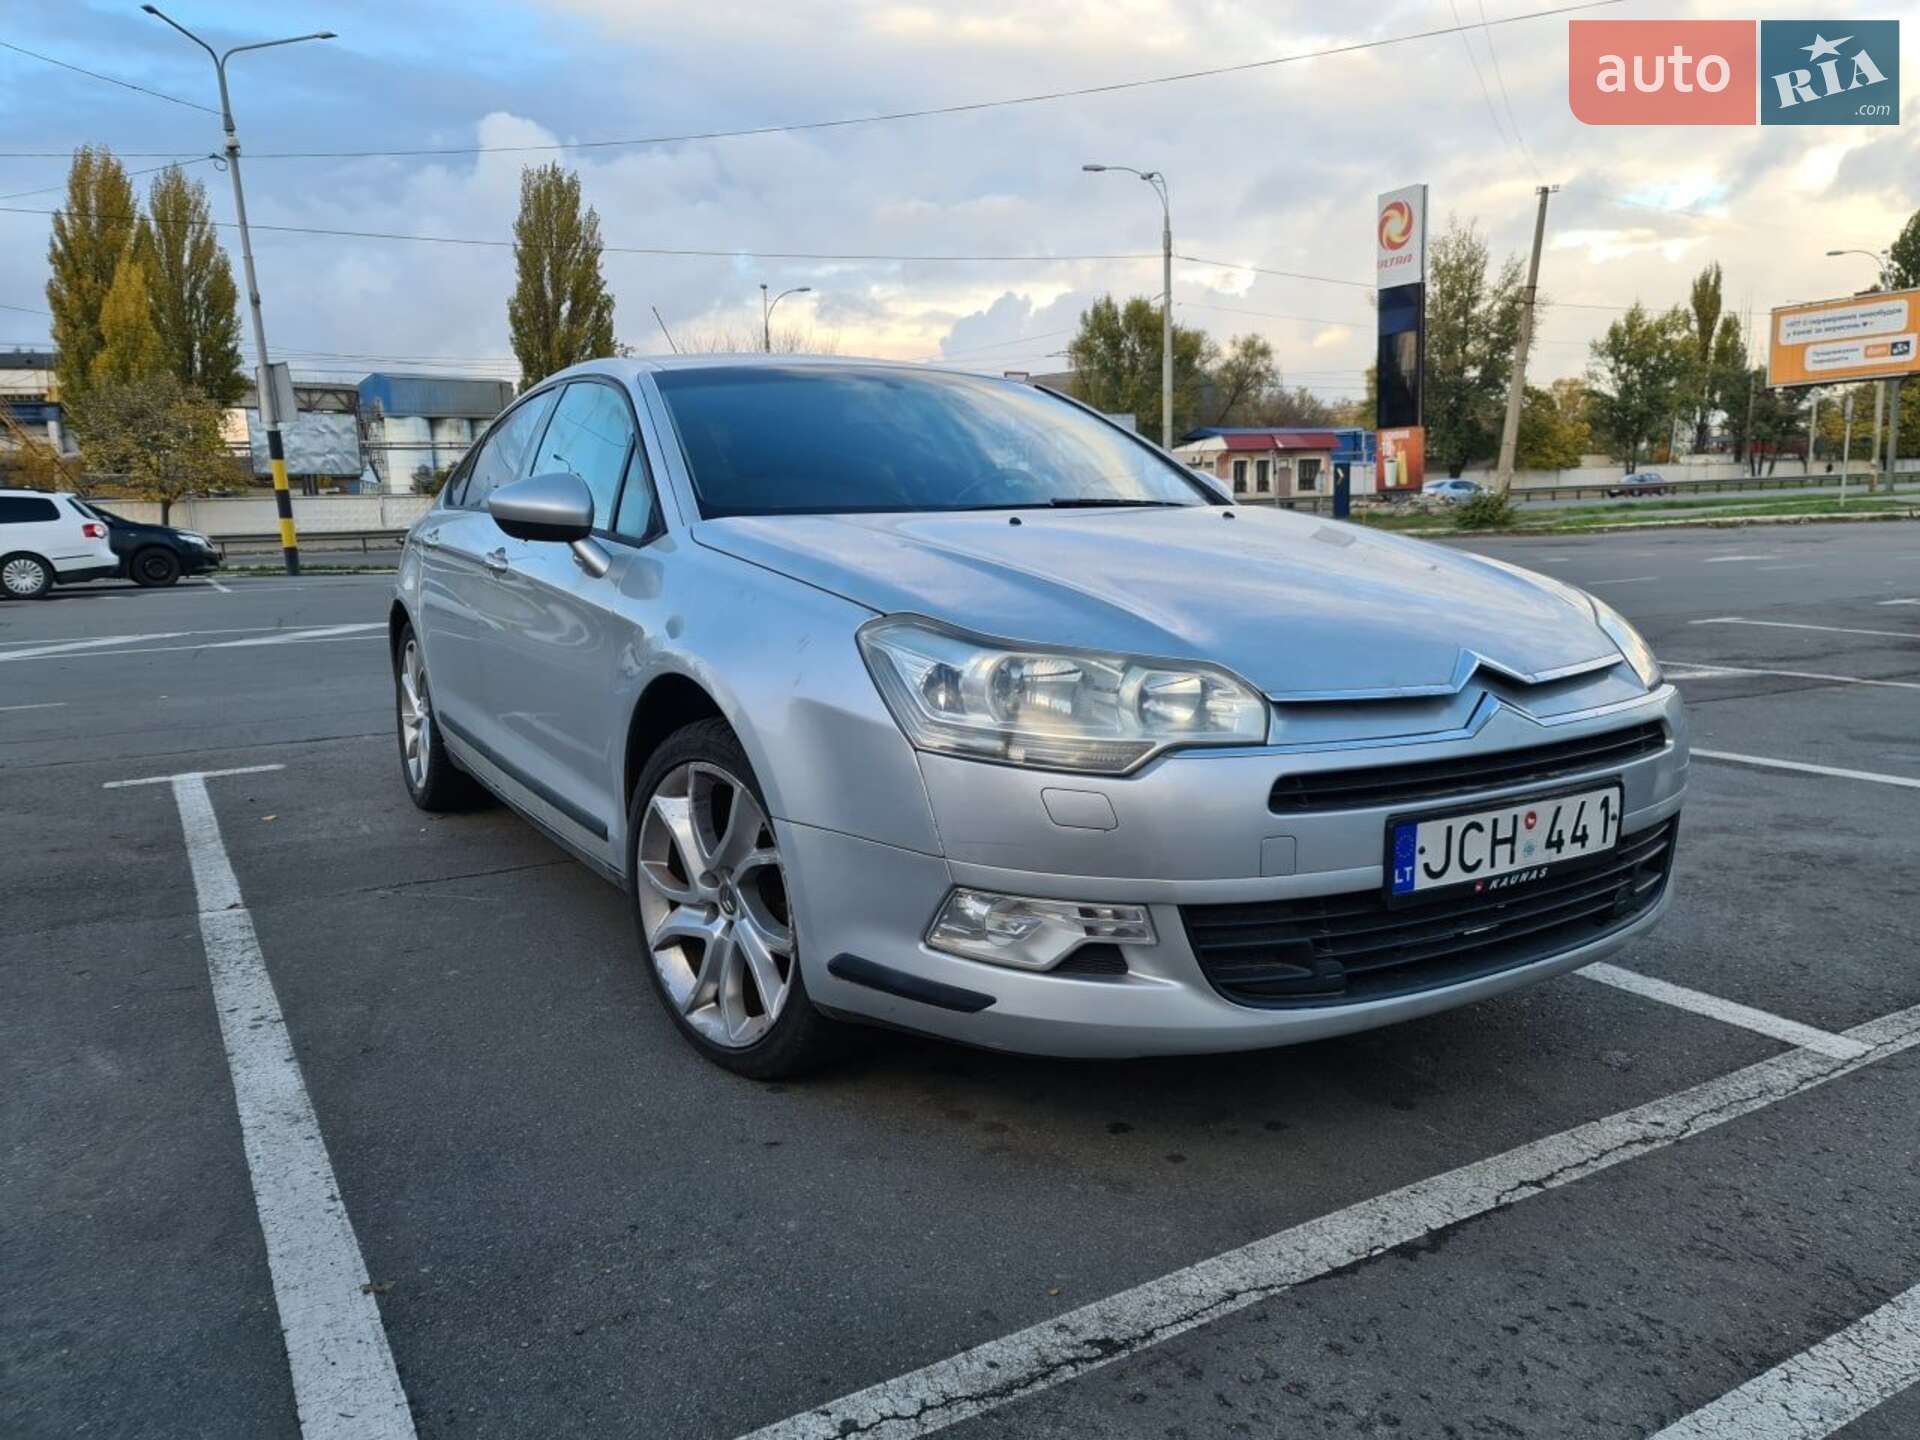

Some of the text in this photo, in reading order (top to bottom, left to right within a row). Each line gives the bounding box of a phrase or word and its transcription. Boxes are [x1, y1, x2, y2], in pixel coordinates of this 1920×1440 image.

[1422, 795, 1611, 880] JCH 441
[1394, 866, 1414, 884] LT
[1489, 867, 1547, 891] KAUNAS
